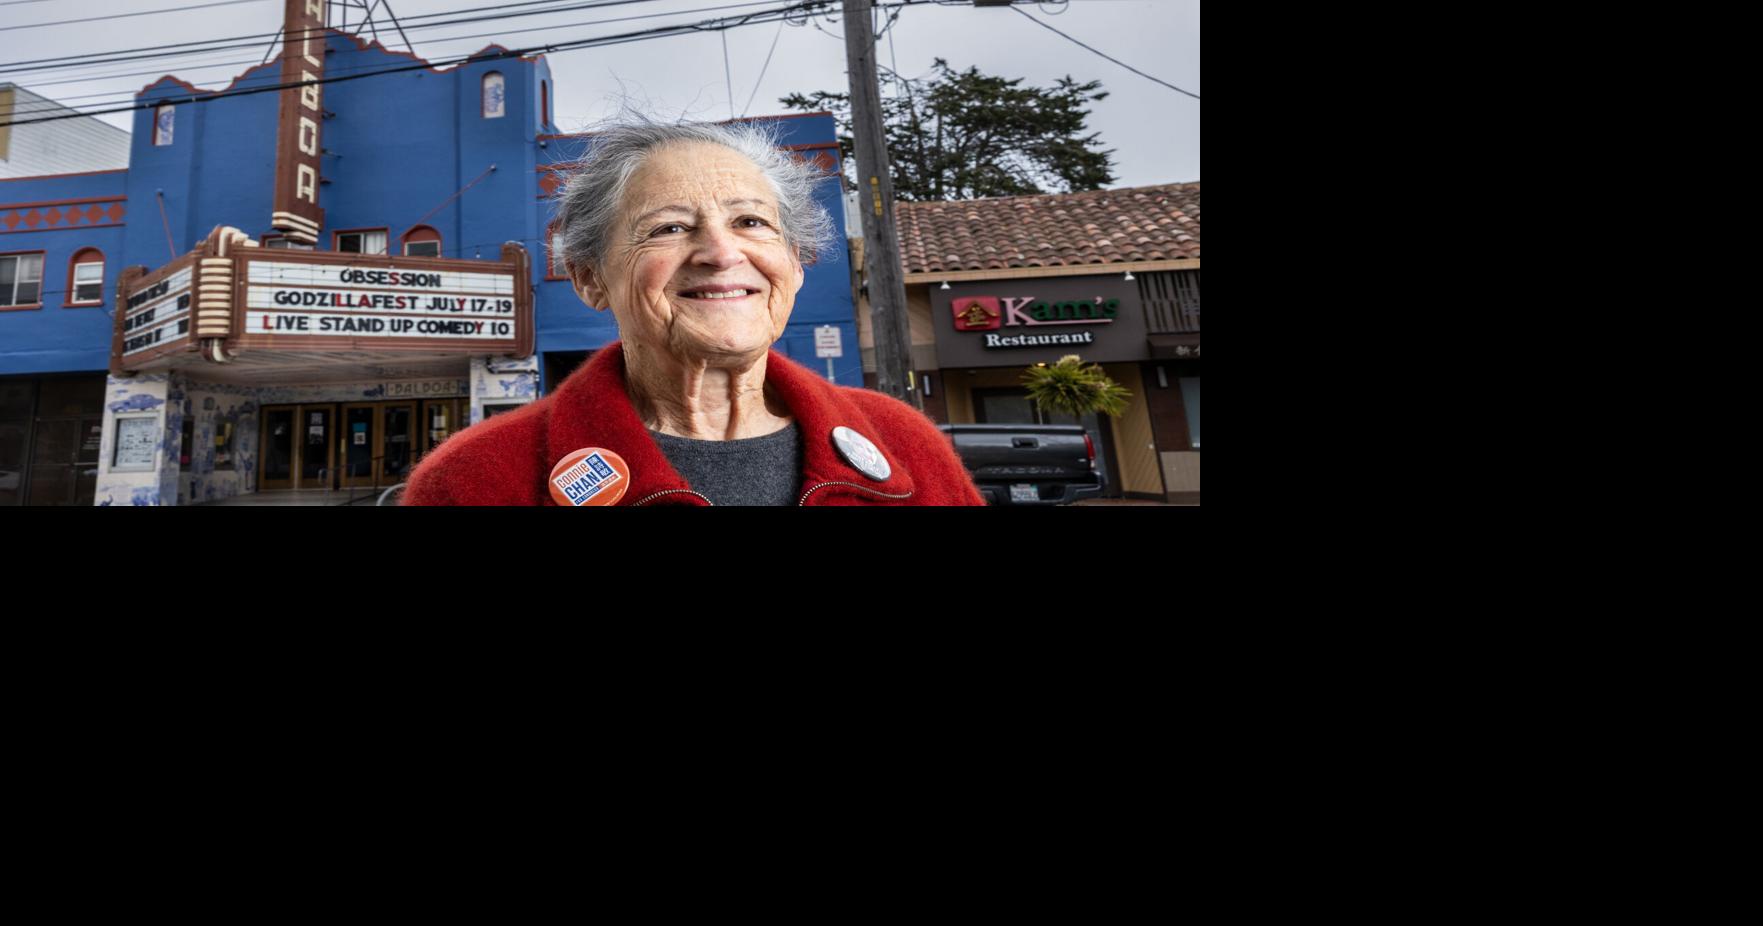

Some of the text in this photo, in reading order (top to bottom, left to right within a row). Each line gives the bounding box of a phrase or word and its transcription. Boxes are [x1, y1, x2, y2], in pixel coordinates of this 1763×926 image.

[340, 269, 441, 287] OBSESSION
[274, 291, 512, 313] GODZILLAFEST JULY 17-19
[1001, 296, 1120, 326] Kam's
[262, 314, 509, 336] LIVE STAND UP COMEDY 10
[985, 331, 1093, 347] Restaurant
[564, 471, 601, 500] CHAN
